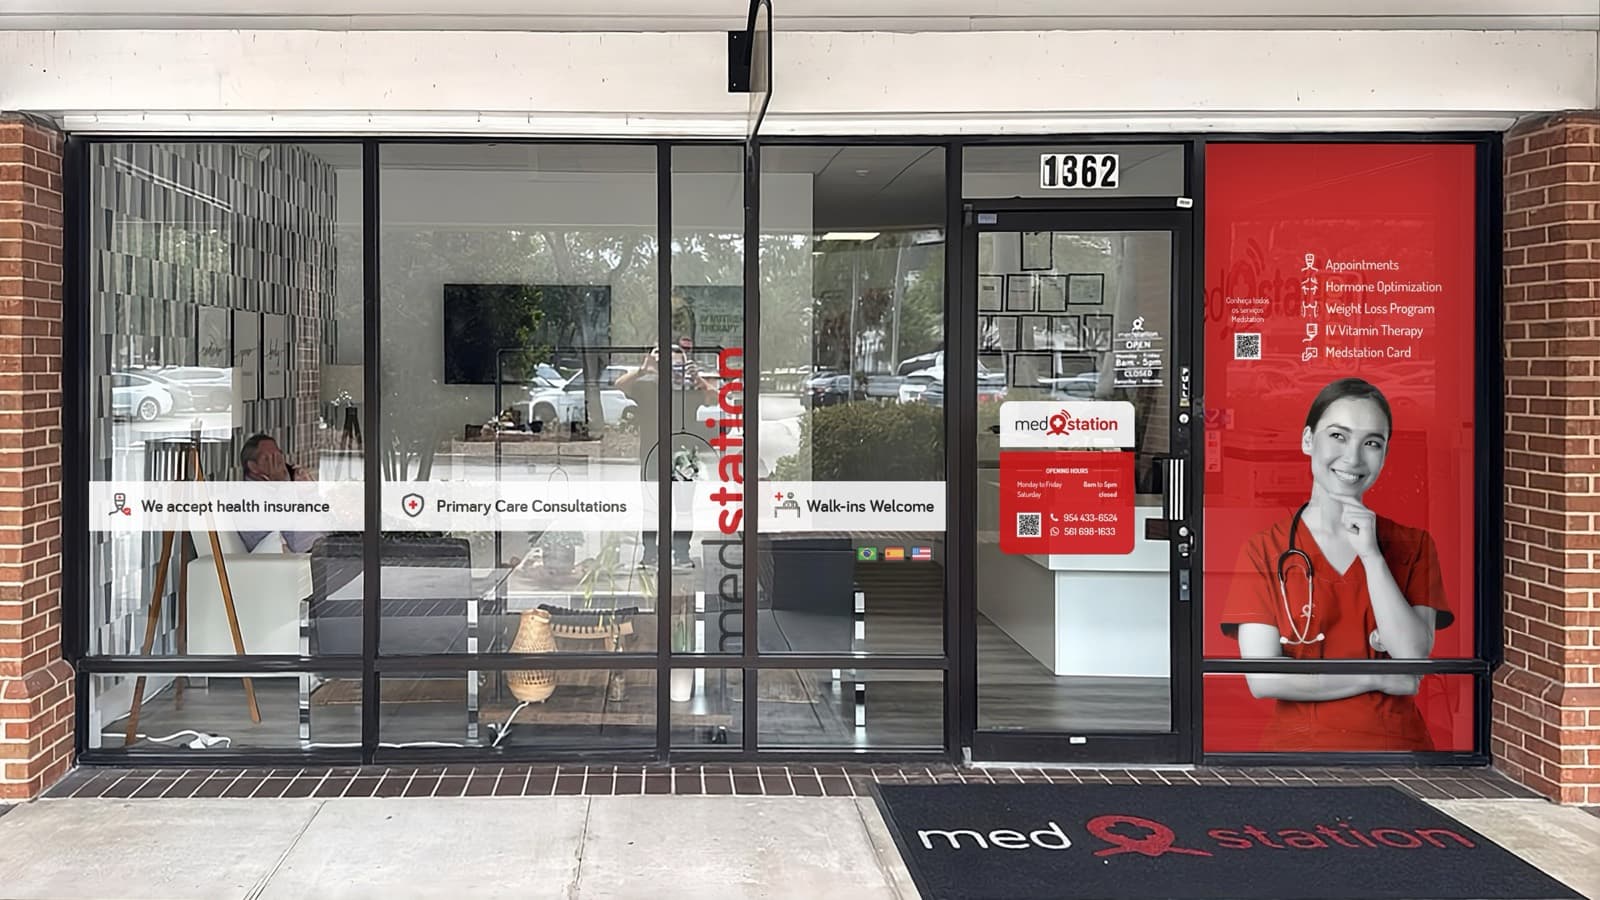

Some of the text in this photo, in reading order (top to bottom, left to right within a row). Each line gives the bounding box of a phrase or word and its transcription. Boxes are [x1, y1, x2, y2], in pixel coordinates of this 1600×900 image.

[1043, 155, 1117, 188] 1362
[1325, 258, 1399, 273] Appointments
[1325, 280, 1442, 295] Hormone Optimization
[1325, 302, 1435, 317] Weight Loss Program
[1325, 324, 1423, 339] IV Vitamin Therapy
[1125, 341, 1152, 349] OPEN
[1325, 346, 1412, 358] Medstation Card
[1124, 369, 1153, 377] CLOSED
[1015, 415, 1118, 431] med station
[707, 346, 744, 535] station
[1016, 481, 1038, 489] Monday
[1045, 481, 1062, 489] Friday
[1016, 491, 1041, 499] Saturday
[141, 497, 330, 517] We accept health insurance
[436, 498, 627, 518] Primary Care Consultations
[807, 498, 935, 514] Walk-ins Welcome
[1063, 513, 1118, 523] 954 433-6524
[1064, 527, 1116, 536] 561 698-1633
[718, 540, 744, 652] med
[917, 818, 1475, 852] med station
